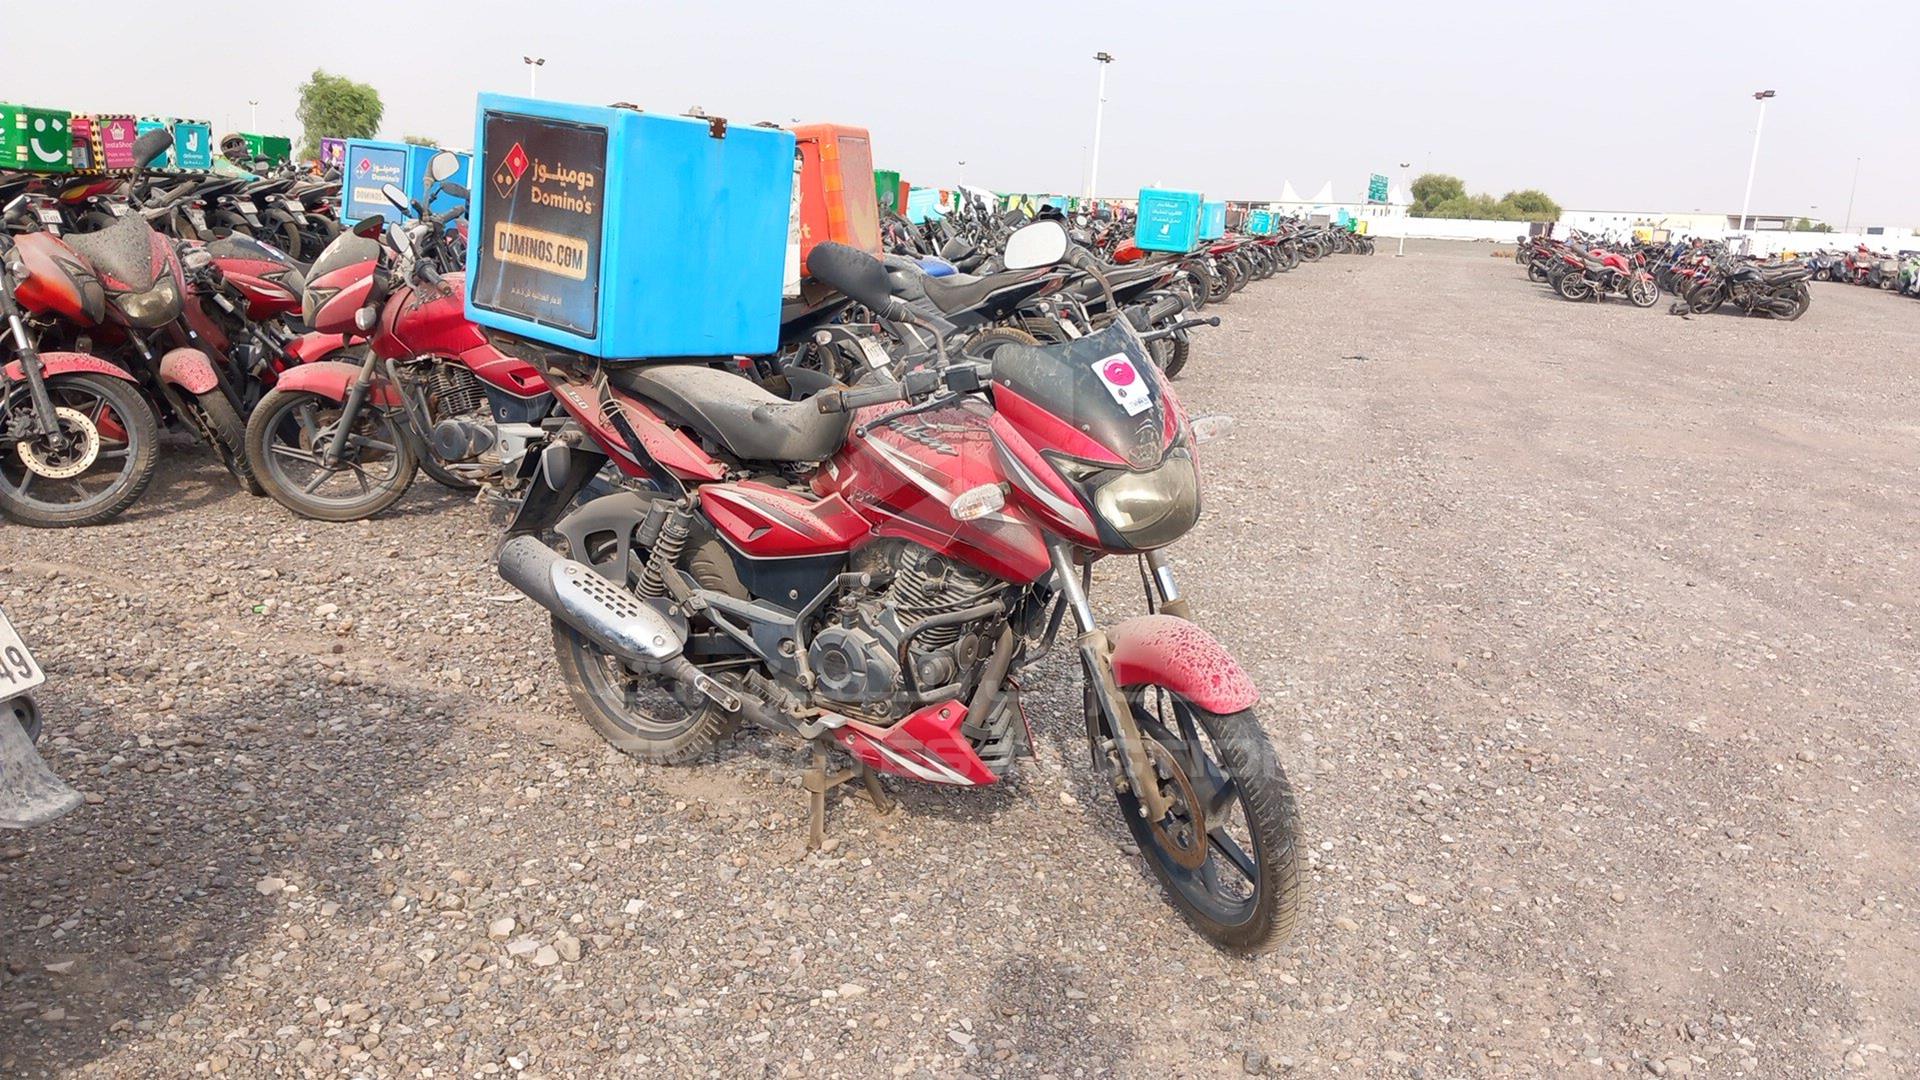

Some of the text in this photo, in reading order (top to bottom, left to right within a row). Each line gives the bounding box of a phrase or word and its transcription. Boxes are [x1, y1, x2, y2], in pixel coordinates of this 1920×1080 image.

[531, 186, 593, 215] Domino's
[500, 231, 583, 270] DOMINOS.COM
[570, 391, 589, 409] 150
